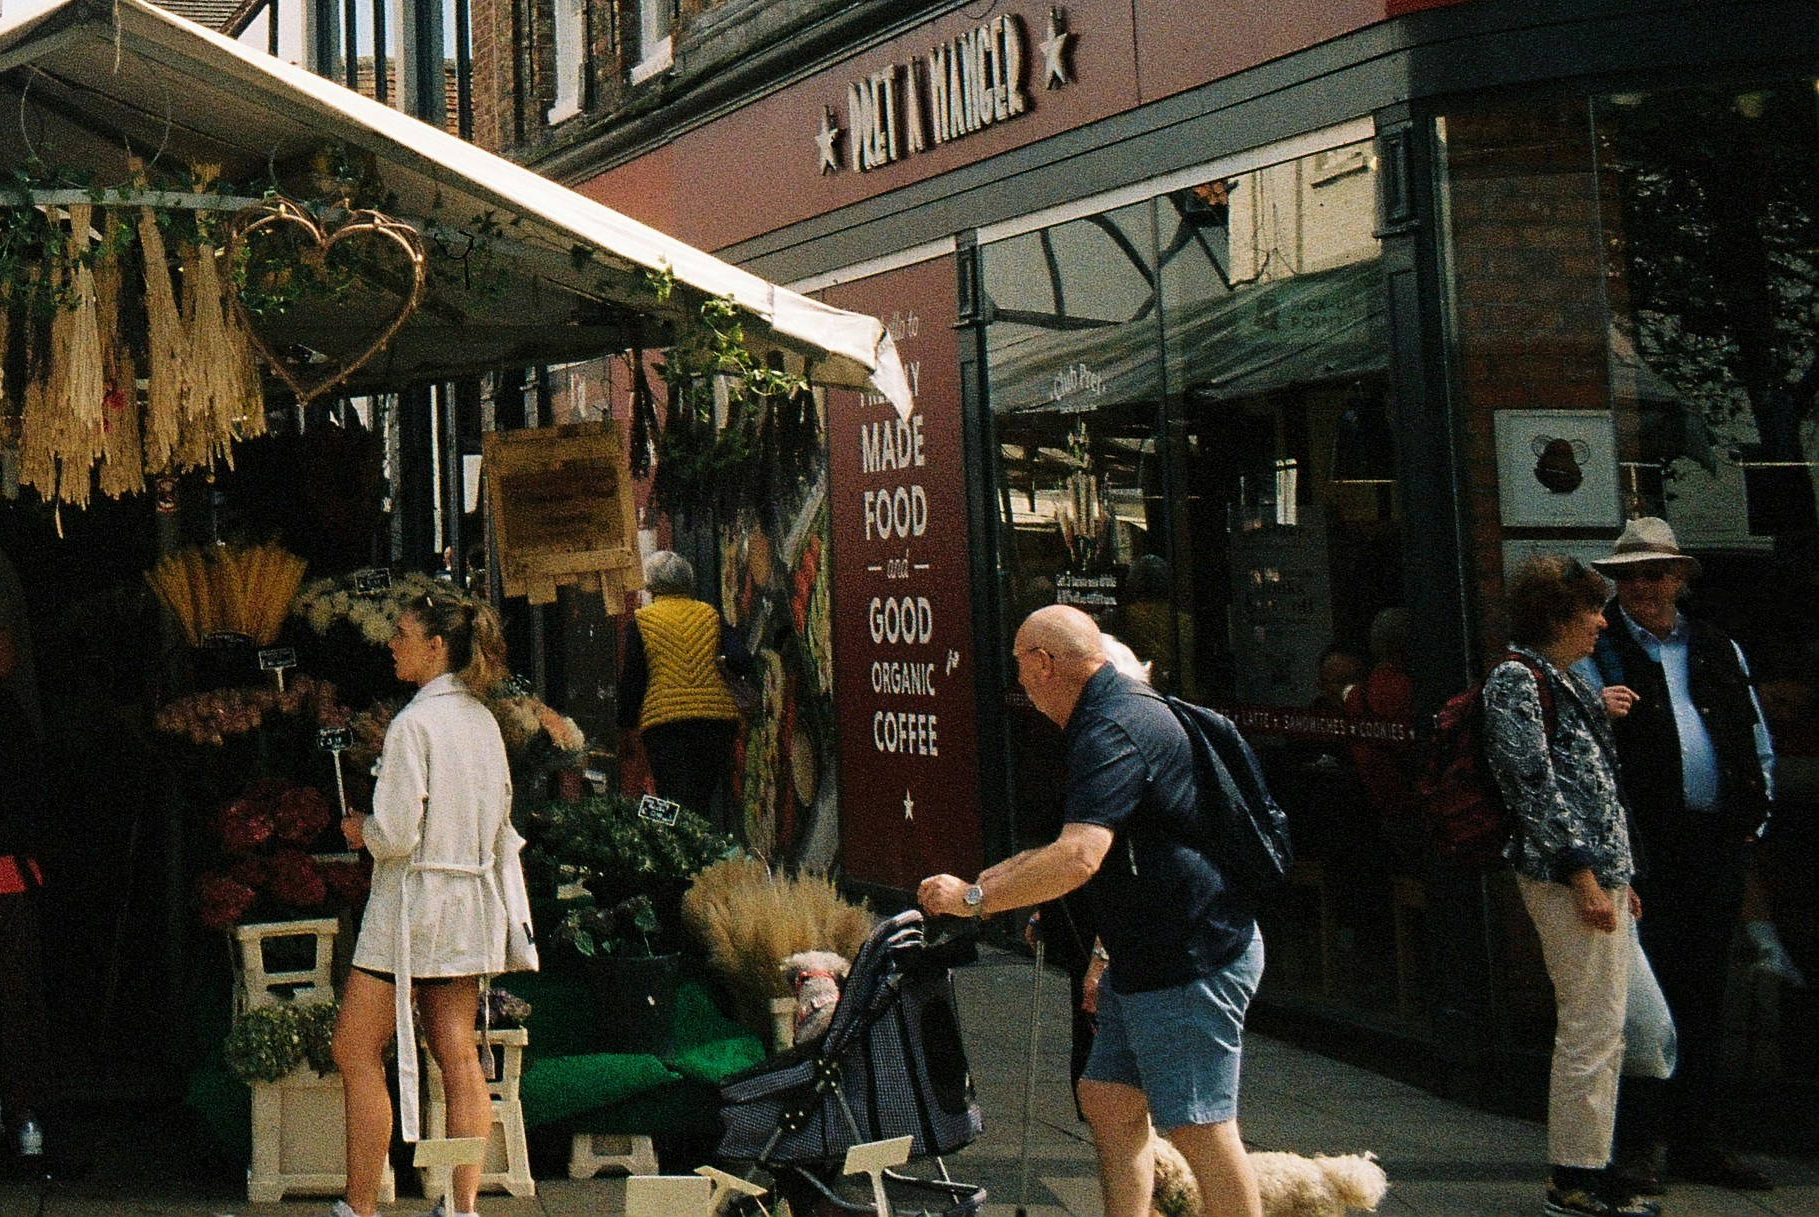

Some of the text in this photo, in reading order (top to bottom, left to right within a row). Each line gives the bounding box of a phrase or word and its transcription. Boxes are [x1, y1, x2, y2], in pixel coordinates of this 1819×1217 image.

[848, 14, 1026, 173] PRET A MANGER
[907, 309, 920, 337] to
[861, 414, 925, 474] MADE
[864, 484, 928, 541] FOOD
[886, 548, 909, 579] and
[869, 596, 932, 645] GOOD
[871, 661, 936, 697] ORGANIC
[873, 710, 938, 757] COFFEE
